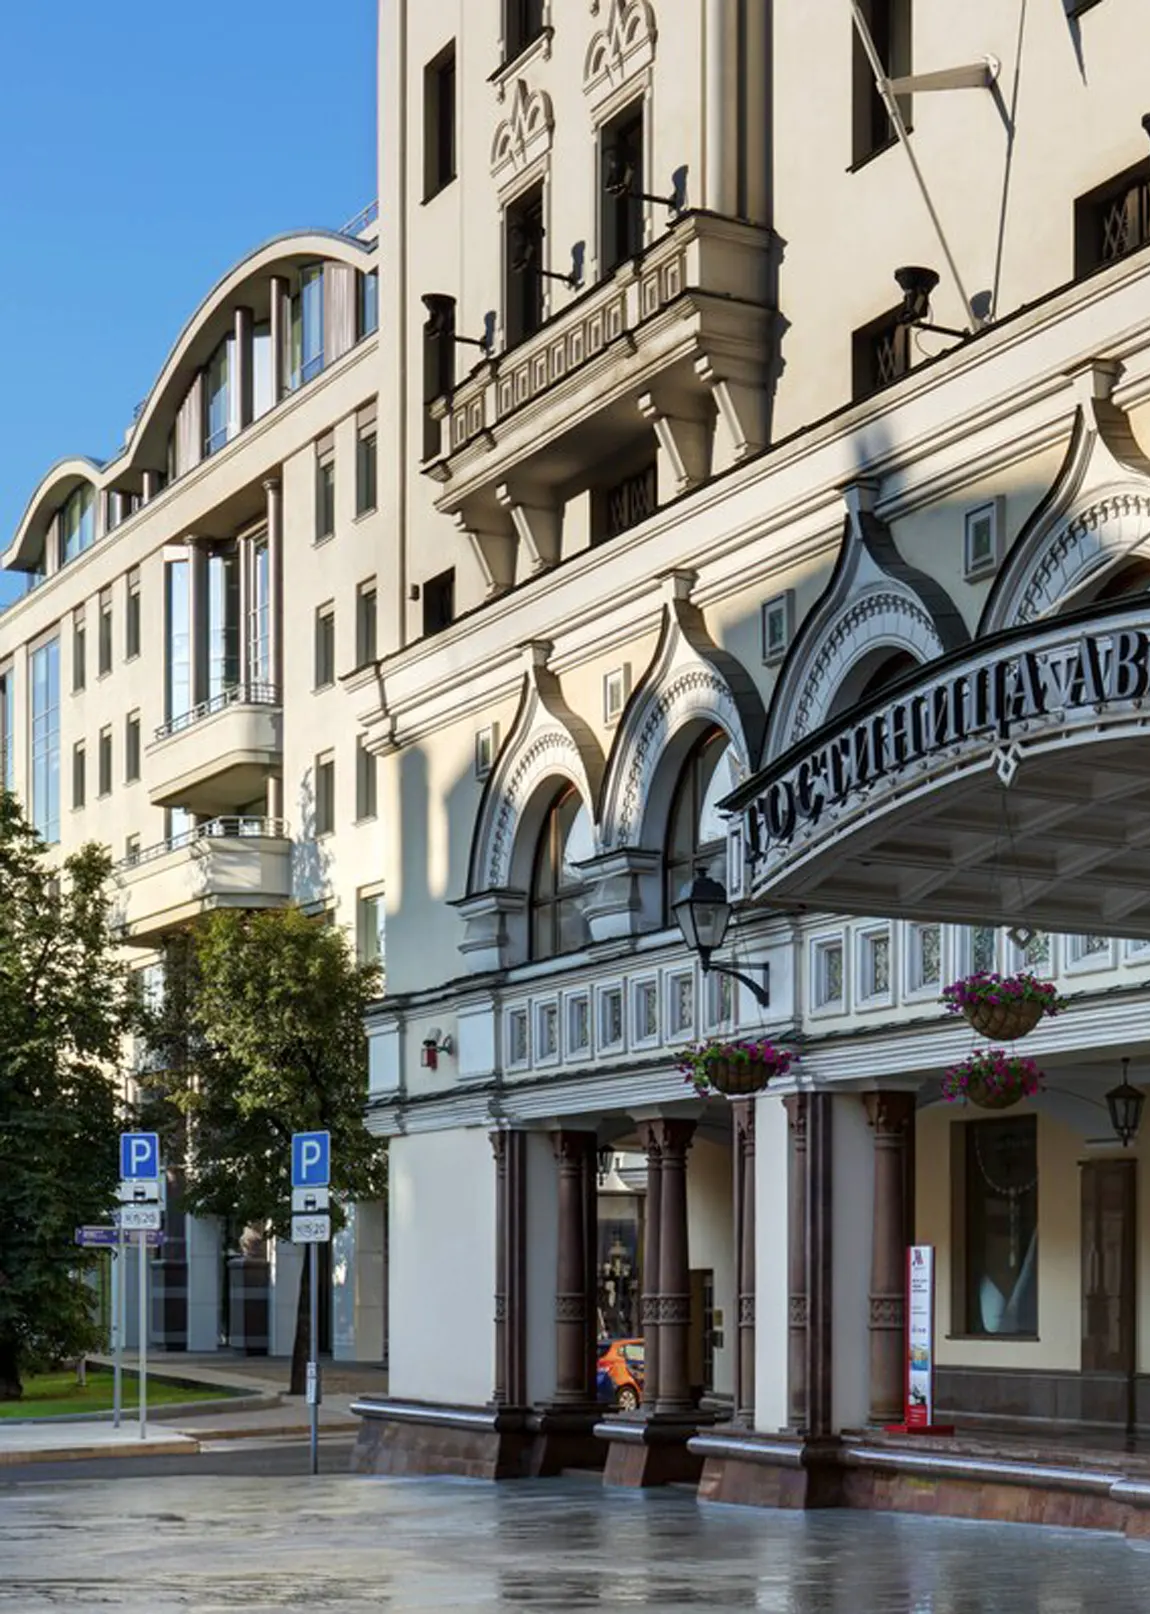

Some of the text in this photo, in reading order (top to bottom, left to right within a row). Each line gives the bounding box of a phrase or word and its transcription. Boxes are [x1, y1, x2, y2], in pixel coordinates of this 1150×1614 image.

[745, 652, 1050, 864] ГОСТИНИЦА
[131, 1138, 151, 1175] P
[301, 1140, 321, 1180] P
